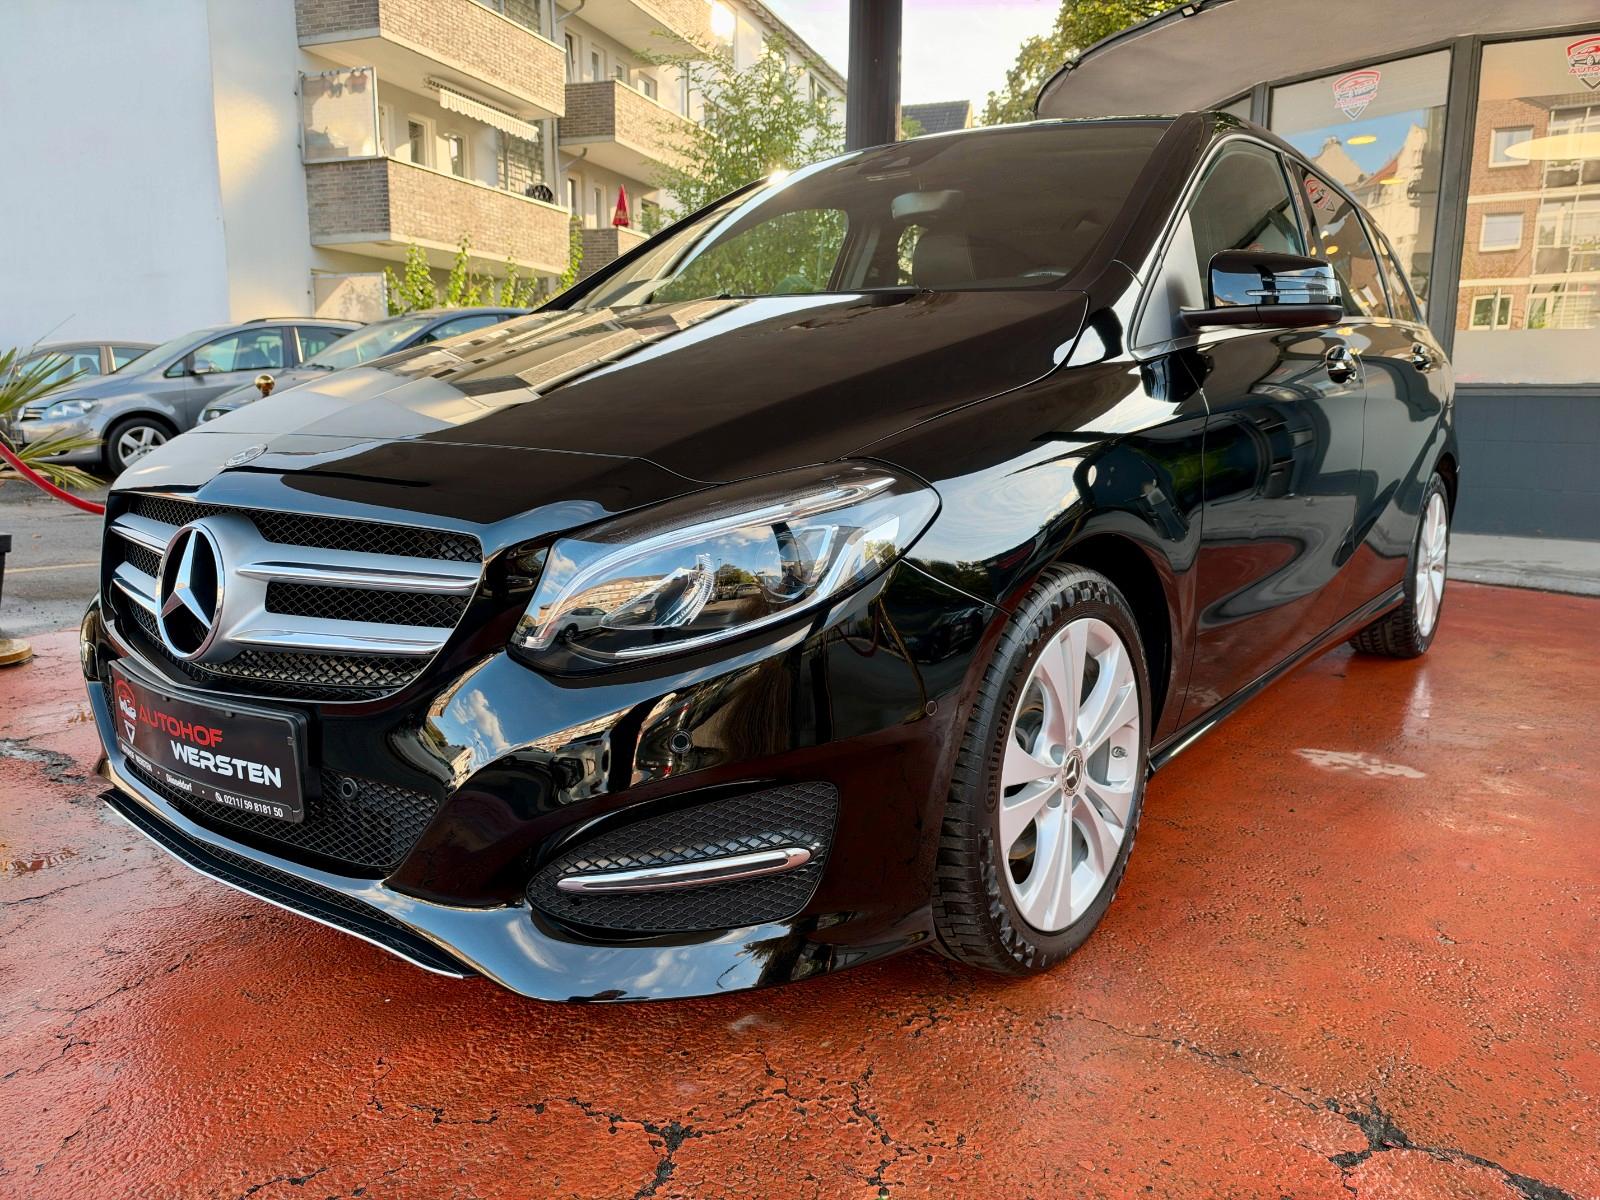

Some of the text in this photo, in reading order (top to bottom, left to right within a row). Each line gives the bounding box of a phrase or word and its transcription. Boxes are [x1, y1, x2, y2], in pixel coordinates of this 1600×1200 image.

[138, 704, 224, 748] AUTOHOF
[170, 739, 282, 789] WERSTEN
[273, 806, 284, 818] 50
